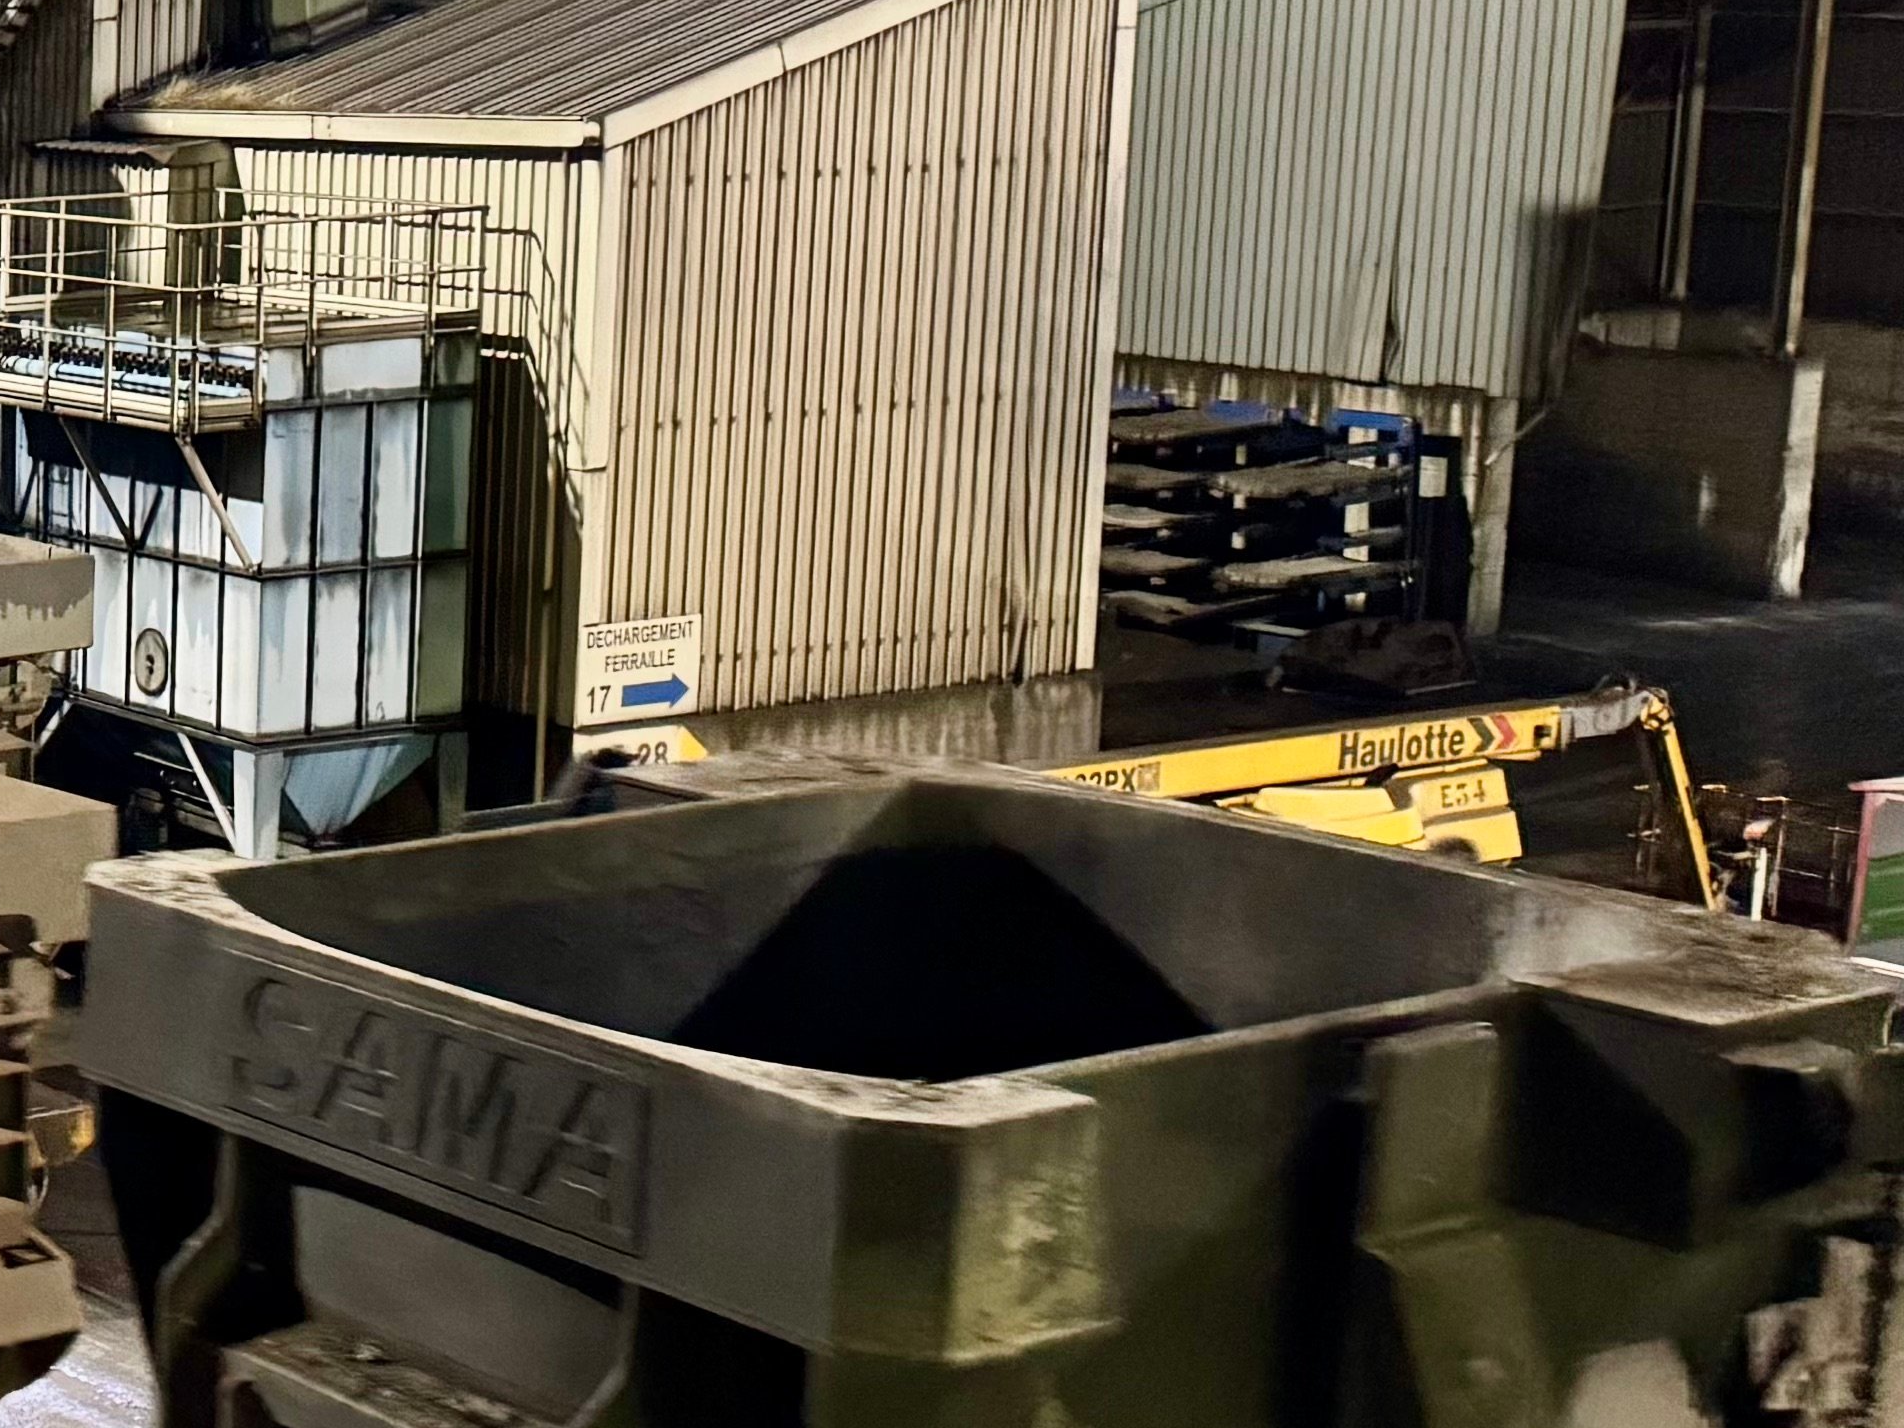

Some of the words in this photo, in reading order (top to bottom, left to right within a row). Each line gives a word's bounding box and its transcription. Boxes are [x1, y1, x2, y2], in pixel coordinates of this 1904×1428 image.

[586, 621, 694, 649] DECHARGEMENT
[604, 648, 676, 673] FERRAILLE
[586, 684, 612, 714] 17
[1337, 723, 1465, 770] Haulotte
[232, 976, 634, 1236] SAMA
